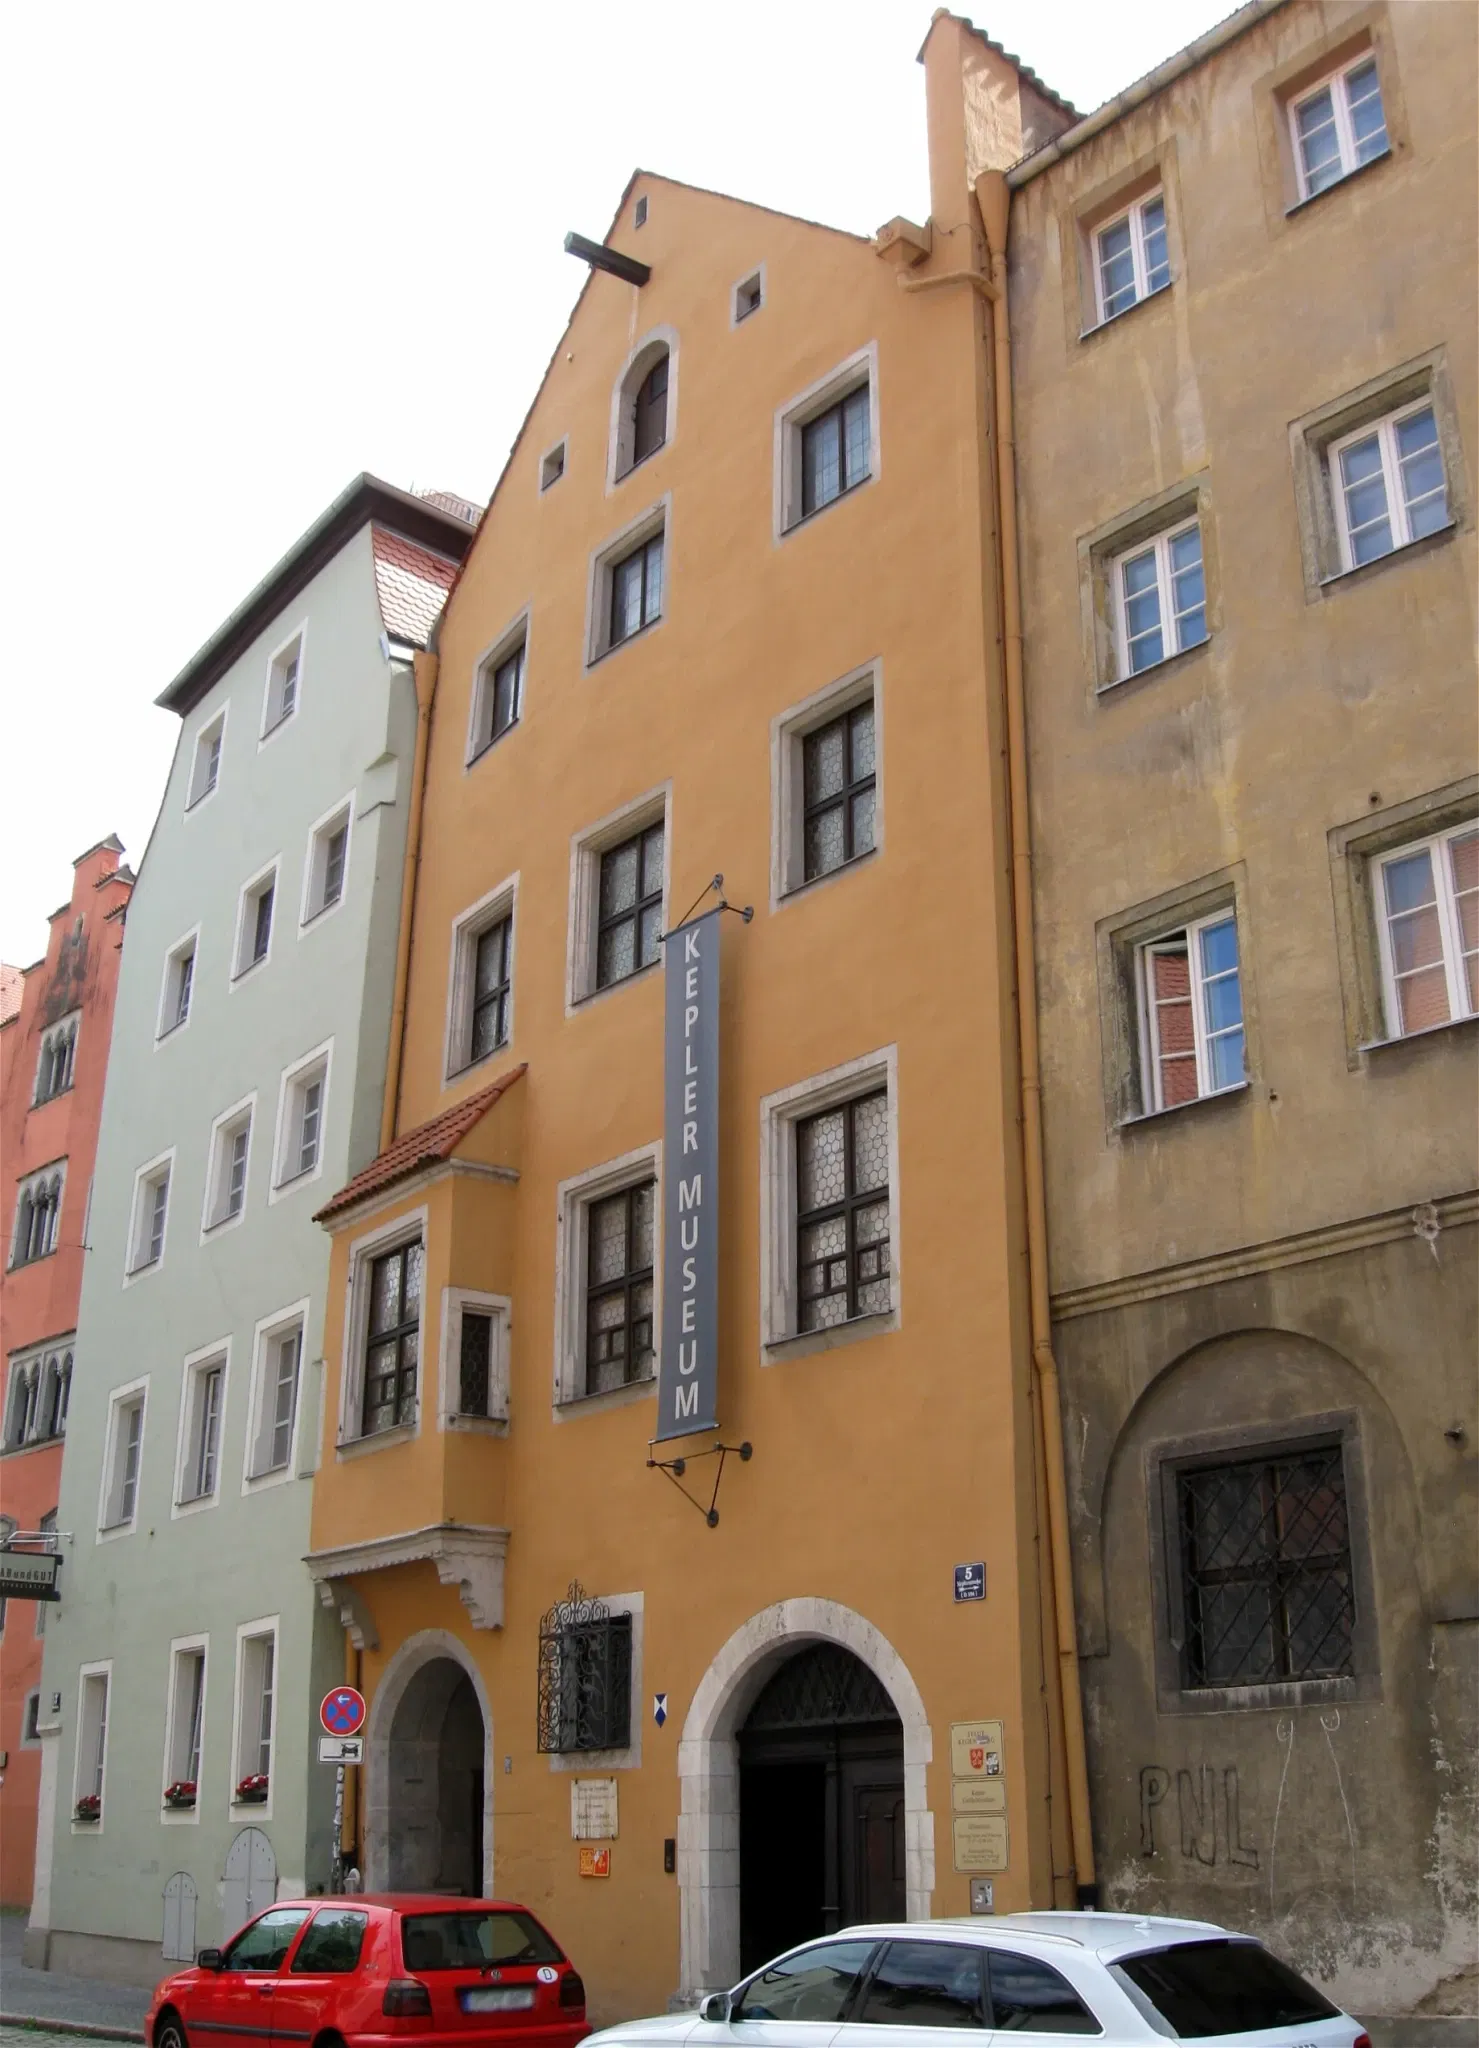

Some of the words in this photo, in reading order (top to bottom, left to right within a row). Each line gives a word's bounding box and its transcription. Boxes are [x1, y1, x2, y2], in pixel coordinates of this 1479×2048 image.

[683, 928, 701, 1154] KEPLER
[674, 1174, 702, 1420] MUSEUM
[964, 1567, 972, 1580] 5
[1140, 1766, 1259, 1870] PNL
[543, 1969, 552, 1979] D
